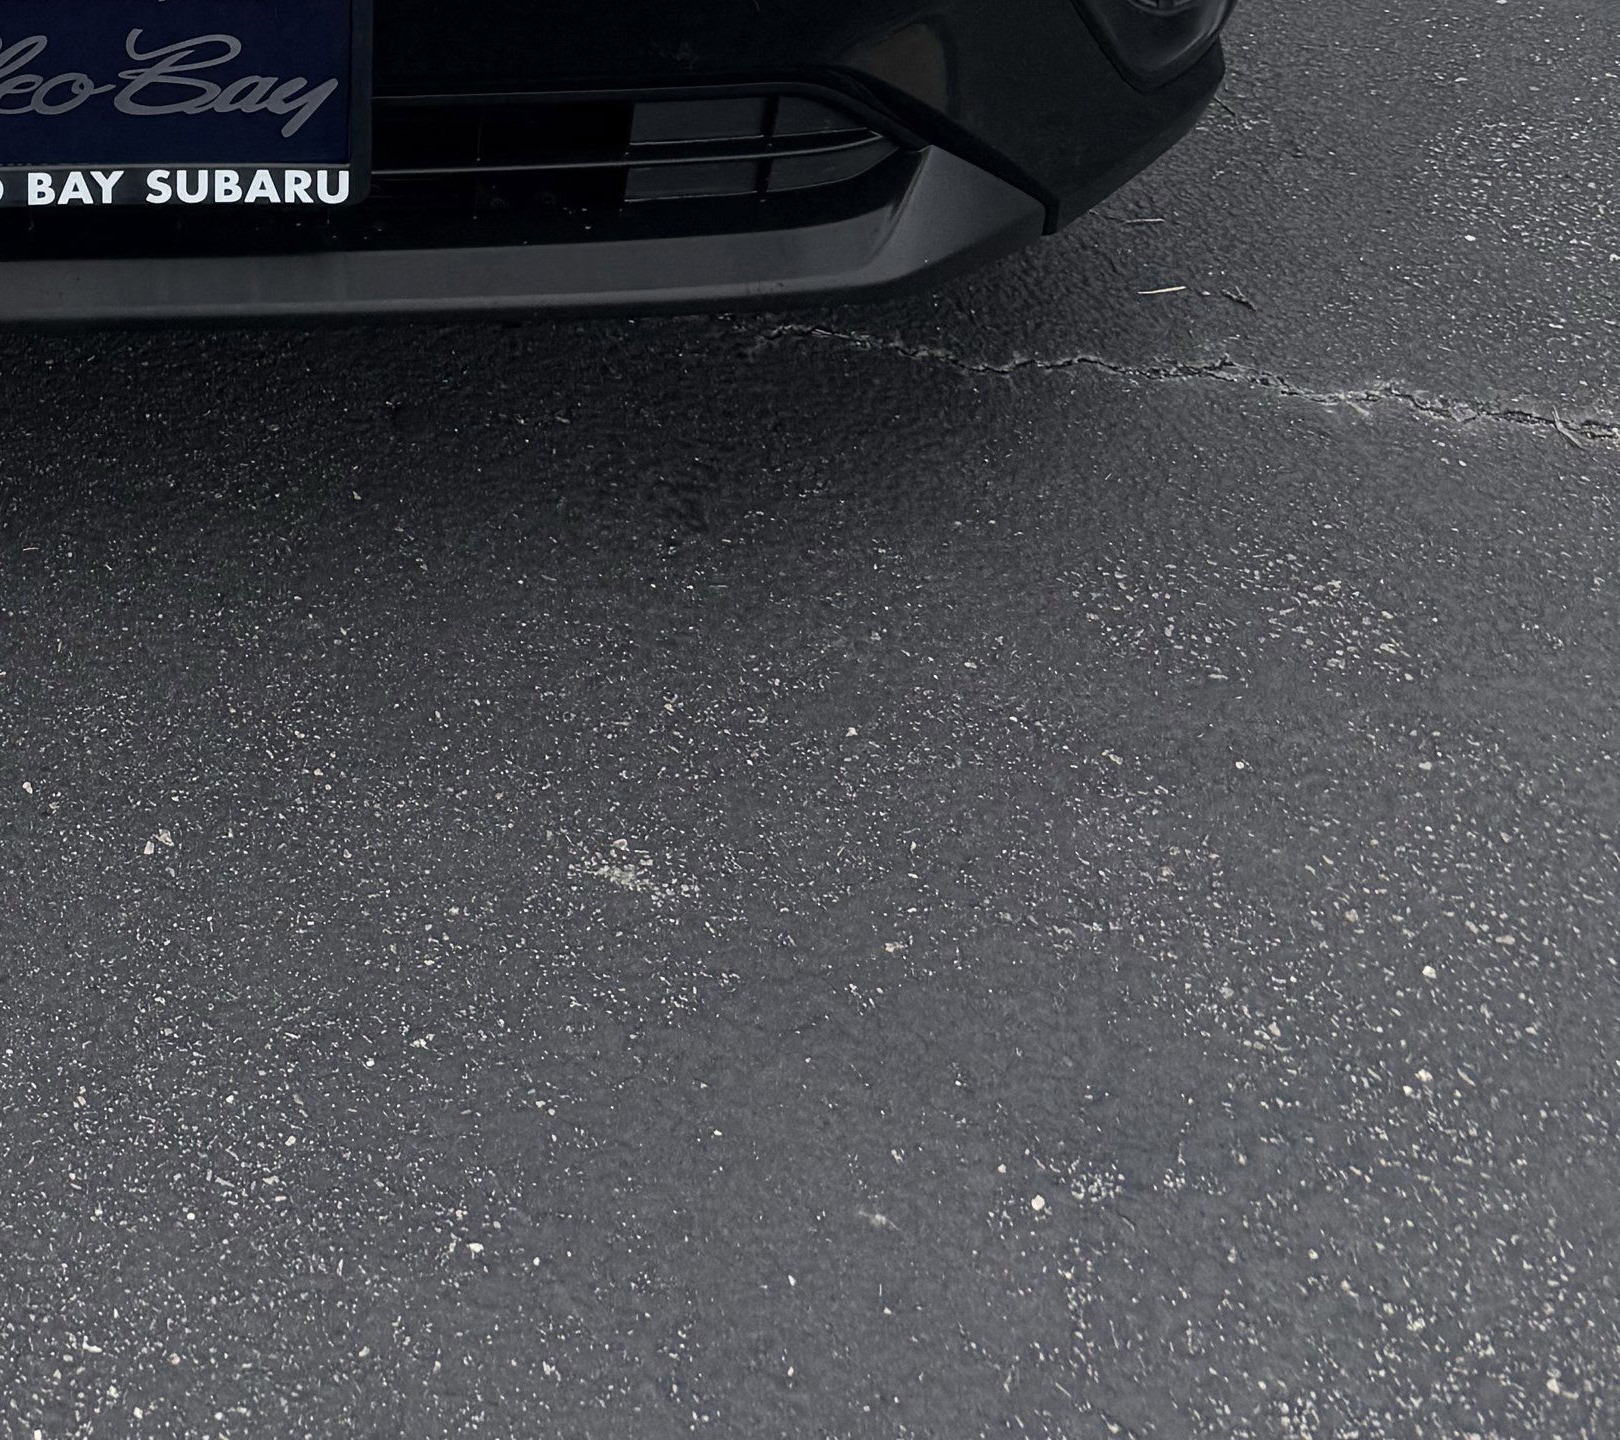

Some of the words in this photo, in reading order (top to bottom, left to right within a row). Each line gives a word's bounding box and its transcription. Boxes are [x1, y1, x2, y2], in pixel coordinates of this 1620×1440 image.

[113, 28, 338, 138] Bay
[26, 170, 125, 206] BAY
[144, 169, 350, 206] SUBARU
